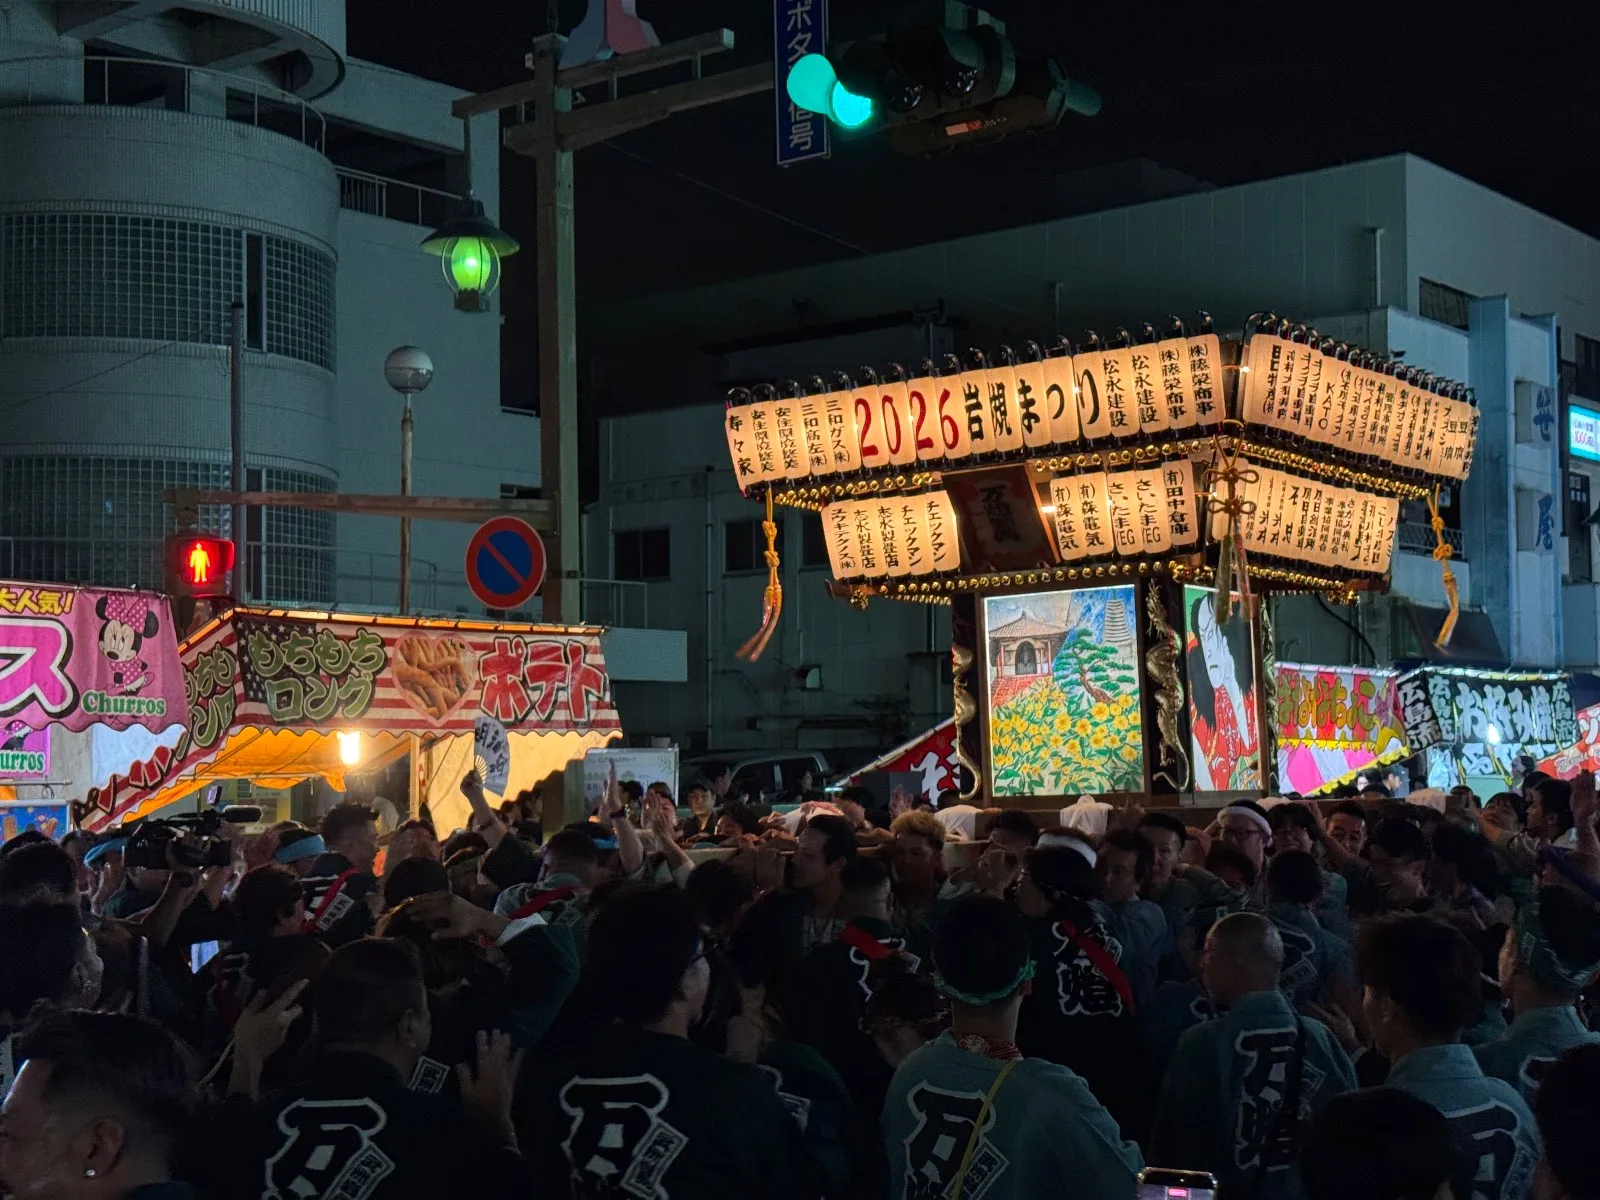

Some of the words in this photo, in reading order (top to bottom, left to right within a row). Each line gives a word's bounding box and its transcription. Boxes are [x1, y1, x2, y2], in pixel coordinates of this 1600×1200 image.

[1103, 358, 1128, 427] 松永建設
[1131, 355, 1160, 424] 松永建設
[1318, 382, 1336, 430] KATO
[248, 628, 388, 677] もちもち
[81, 690, 167, 717] Churros
[264, 671, 377, 723] ロング
[479, 636, 605, 725] ポテト
